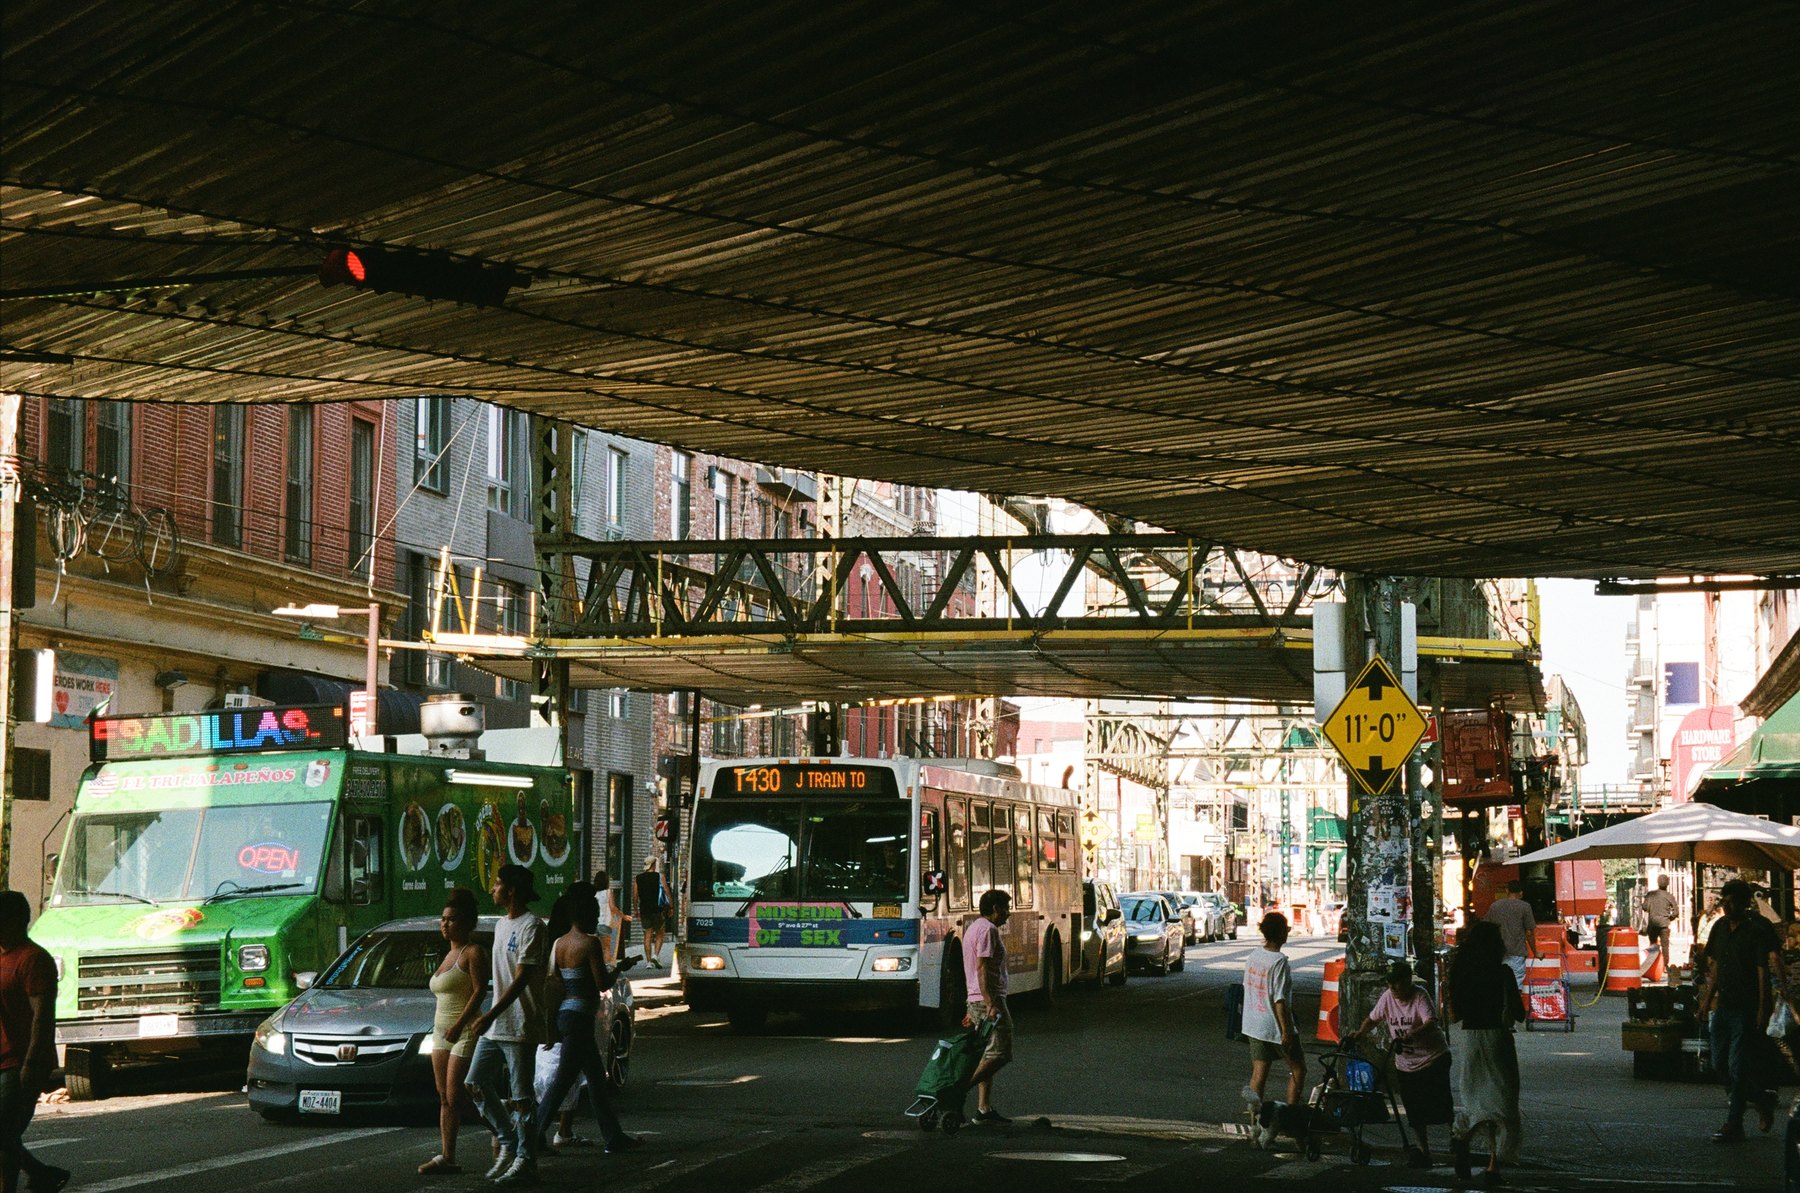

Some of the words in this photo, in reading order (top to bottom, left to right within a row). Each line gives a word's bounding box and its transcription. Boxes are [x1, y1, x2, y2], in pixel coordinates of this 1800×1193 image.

[54, 676, 75, 689] EROES
[76, 680, 95, 691] WORK
[1681, 729, 1731, 745] HARDWARE
[1691, 746, 1721, 761] STORE
[122, 775, 145, 790] EL
[150, 774, 181, 788] TRI
[183, 767, 297, 787] JALAPEÑOS
[733, 768, 781, 792] T430
[795, 772, 803, 788] J
[807, 772, 846, 788] TRAIN
[850, 772, 866, 788] TO
[239, 845, 299, 871] OPEN
[756, 906, 843, 921] MUSEUM
[696, 919, 714, 927] 7025
[755, 929, 781, 945] OF
[800, 929, 841, 946] SEX
